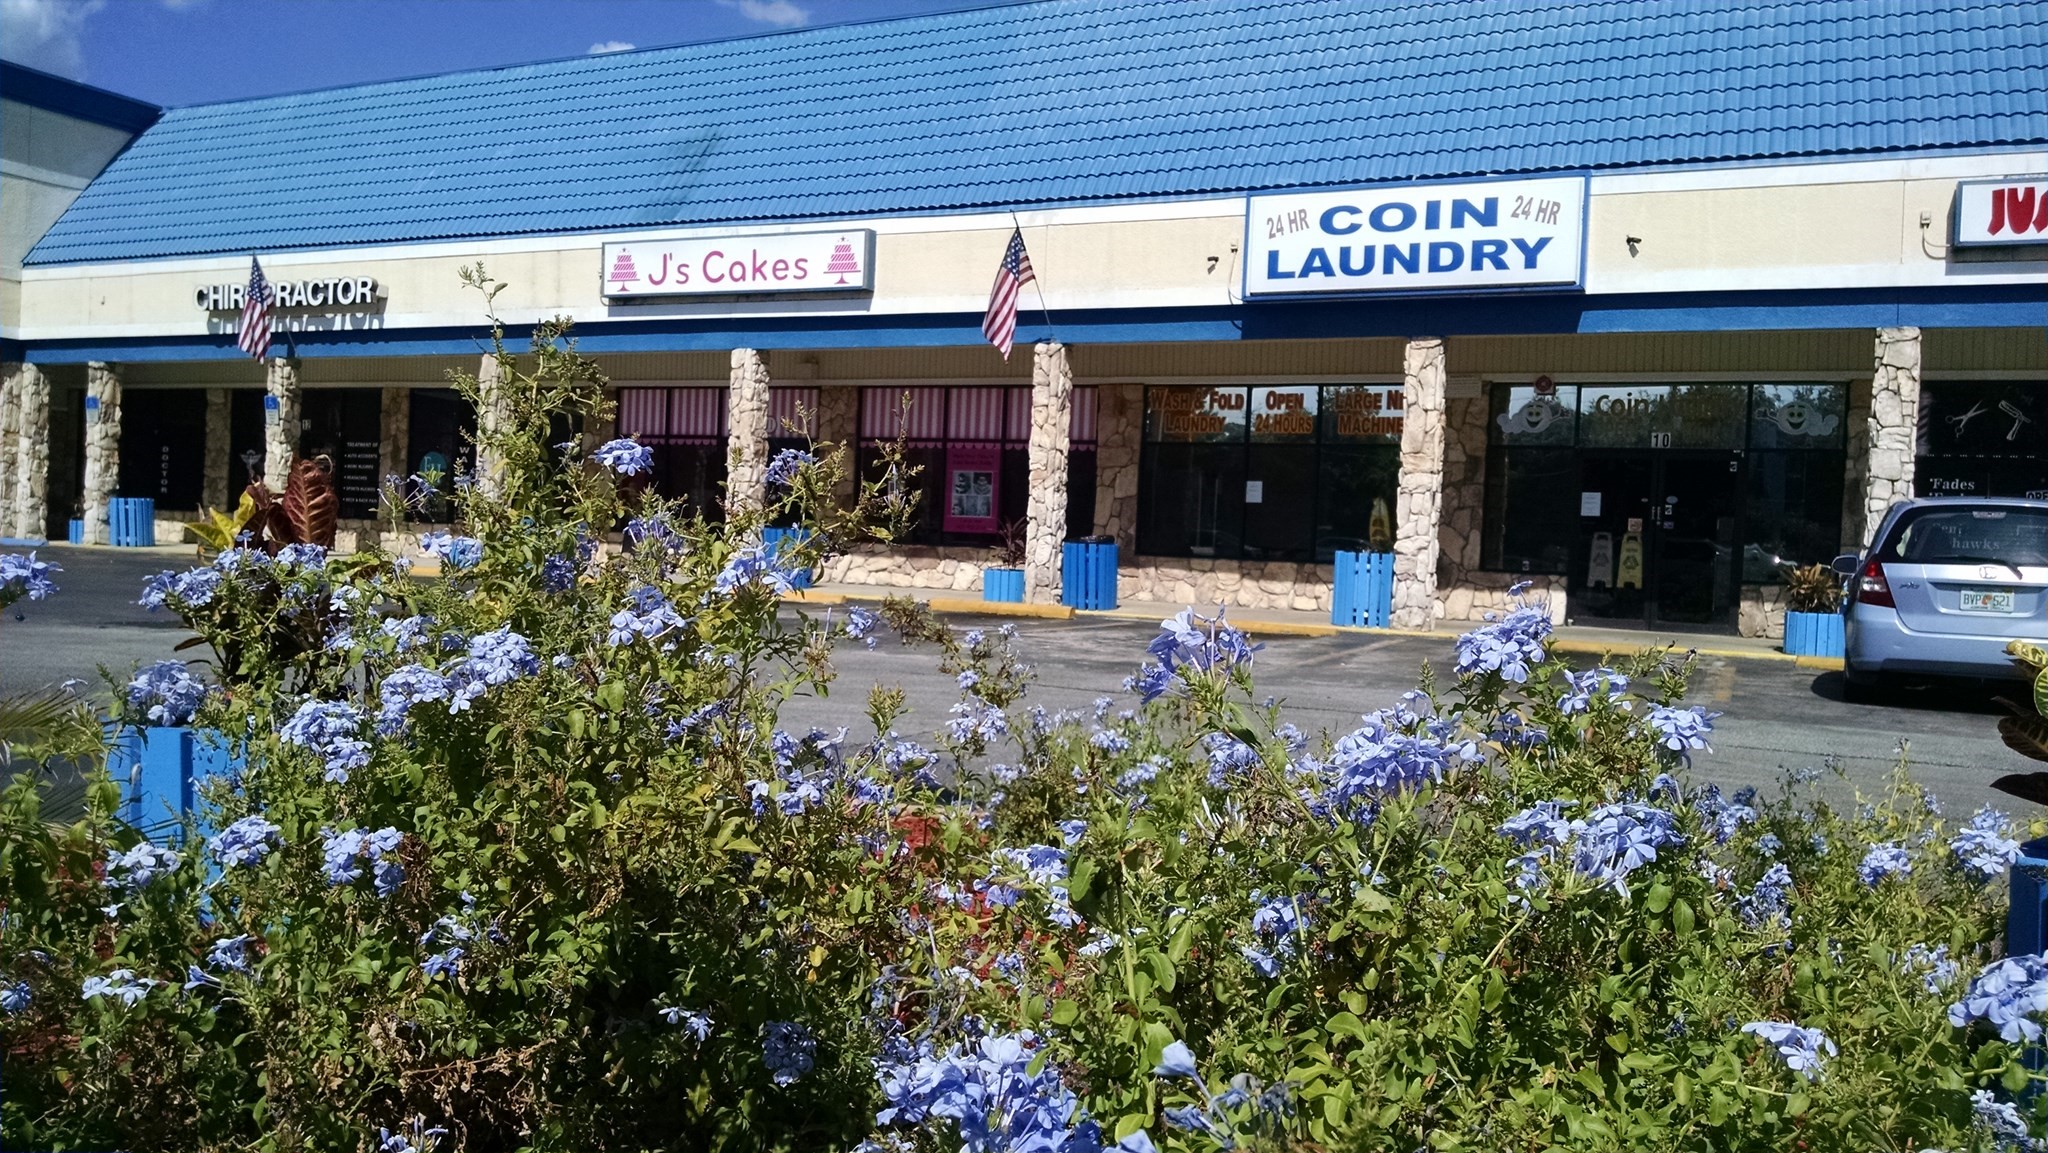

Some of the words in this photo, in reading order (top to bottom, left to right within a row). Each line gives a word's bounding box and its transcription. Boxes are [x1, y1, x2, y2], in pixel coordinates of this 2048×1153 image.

[1266, 214, 1284, 239] 24
[1288, 208, 1309, 234] HR
[1319, 197, 1499, 235] COIN
[1510, 195, 1531, 221] 24
[1535, 199, 1561, 225] HR
[648, 252, 690, 286] J's
[702, 249, 808, 283] Cakes
[1267, 236, 1554, 280] LAUNDRY
[194, 276, 373, 311] CHIRRACTOR
[1149, 388, 1191, 411] WASH
[1194, 391, 1204, 411] &
[1210, 390, 1245, 411] FOLD
[1265, 390, 1304, 411] OPEN
[1335, 391, 1383, 411] LARGE
[1595, 392, 1650, 417] Coin
[1164, 413, 1226, 433] LAUNDRY
[1255, 414, 1269, 433] 24
[1273, 414, 1313, 433] HOURS
[1652, 433, 1671, 448] 10
[160, 445, 169, 494] DOCTOR
[1951, 537, 2000, 549] hawks
[1963, 594, 1982, 605] BVP
[1993, 595, 2010, 607] 521
